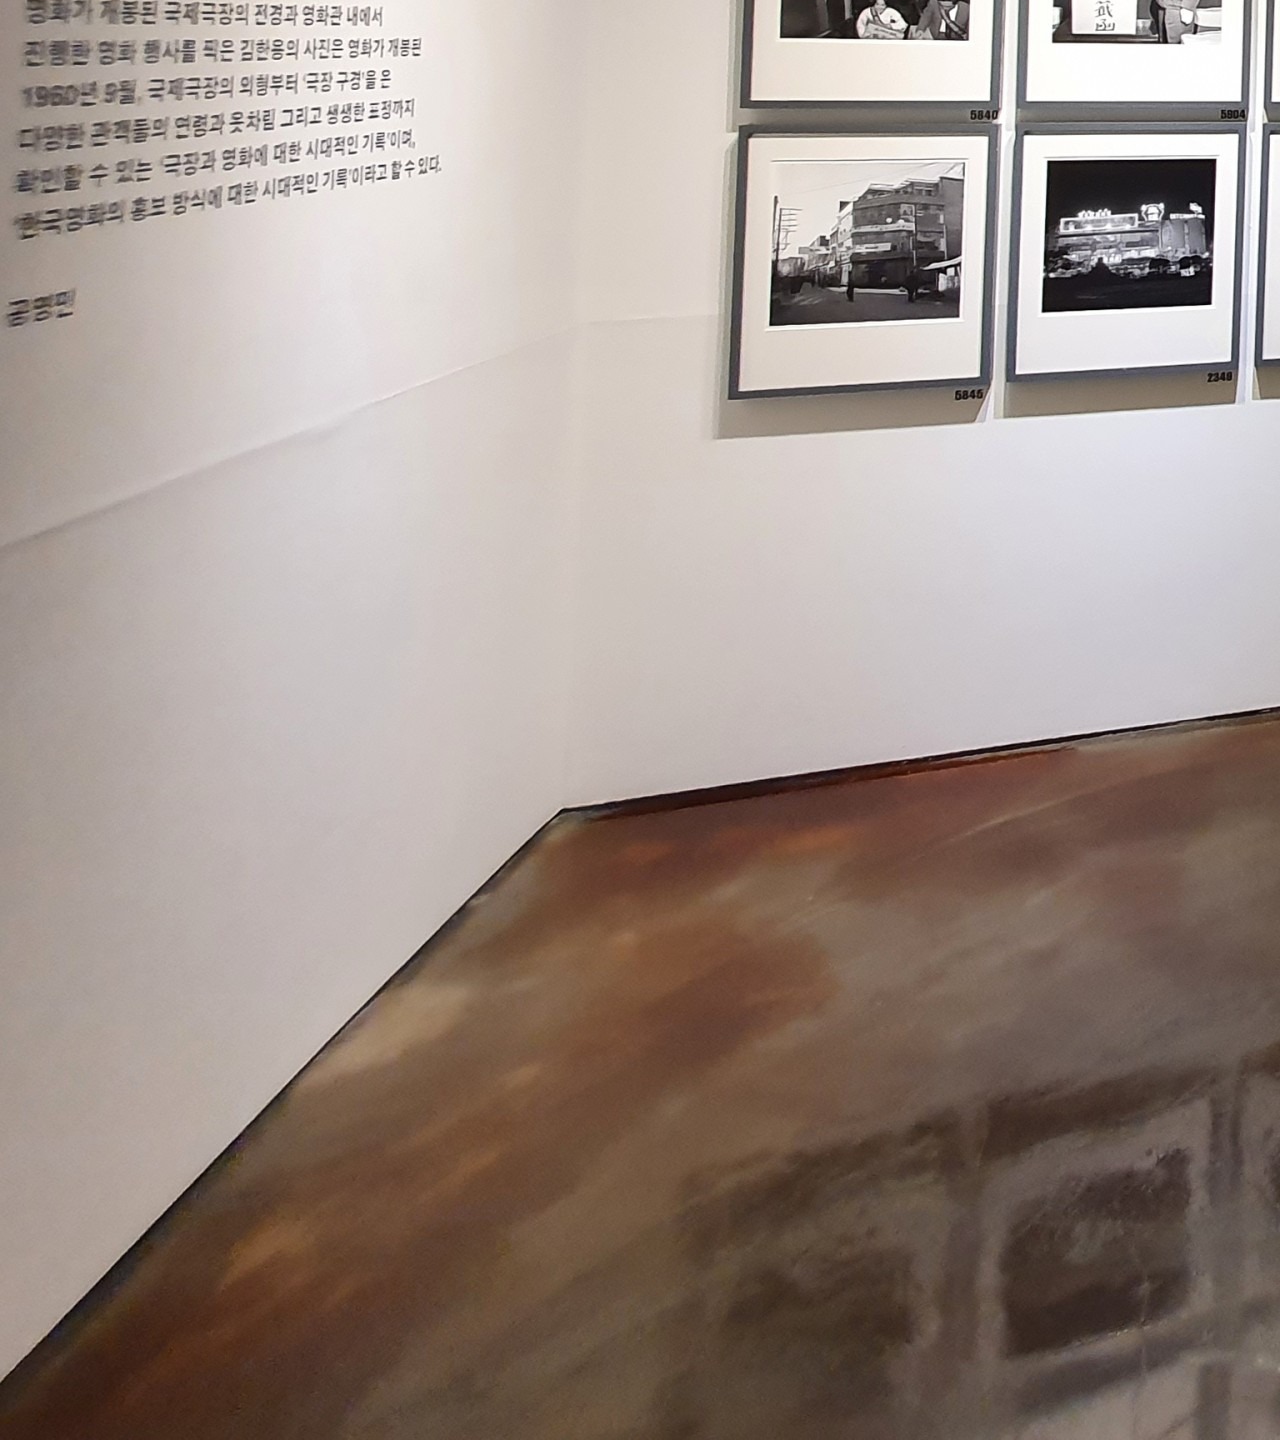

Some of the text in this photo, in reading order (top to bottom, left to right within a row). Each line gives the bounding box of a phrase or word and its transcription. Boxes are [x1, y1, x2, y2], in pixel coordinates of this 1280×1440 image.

[99, 0, 158, 25] 개봉된
[164, 1, 249, 26] 국제극장의
[254, 4, 298, 26] 전경과
[302, 5, 343, 26] 영화관
[347, 6, 383, 27] 내에서
[99, 40, 136, 66] 영화
[144, 39, 196, 64] 행사를
[239, 38, 299, 62] 김한용의
[303, 38, 344, 60] 사진은
[348, 38, 384, 59] 영화가
[387, 37, 422, 57] 개봉된
[147, 75, 234, 102] 국제극장의
[91, 118, 170, 147] 관객들의
[175, 112, 224, 140] 연령과
[229, 108, 276, 134] 옷차림
[280, 106, 322, 128] 그리고
[326, 101, 365, 125] 생생한
[368, 97, 416, 120] 표정까지
[970, 109, 998, 120] 5840
[1220, 109, 1246, 120] 5904
[88, 163, 109, 187] 수
[115, 159, 153, 185] 있는
[222, 146, 268, 171] 영화에
[273, 141, 302, 164] 대한
[306, 134, 359, 160] 시대적인
[130, 195, 166, 222] 홍보
[173, 185, 223, 216] 방식에
[227, 181, 259, 206] 대한
[263, 172, 319, 200] 시대적인
[391, 159, 402, 179] 할
[404, 158, 416, 177] 수
